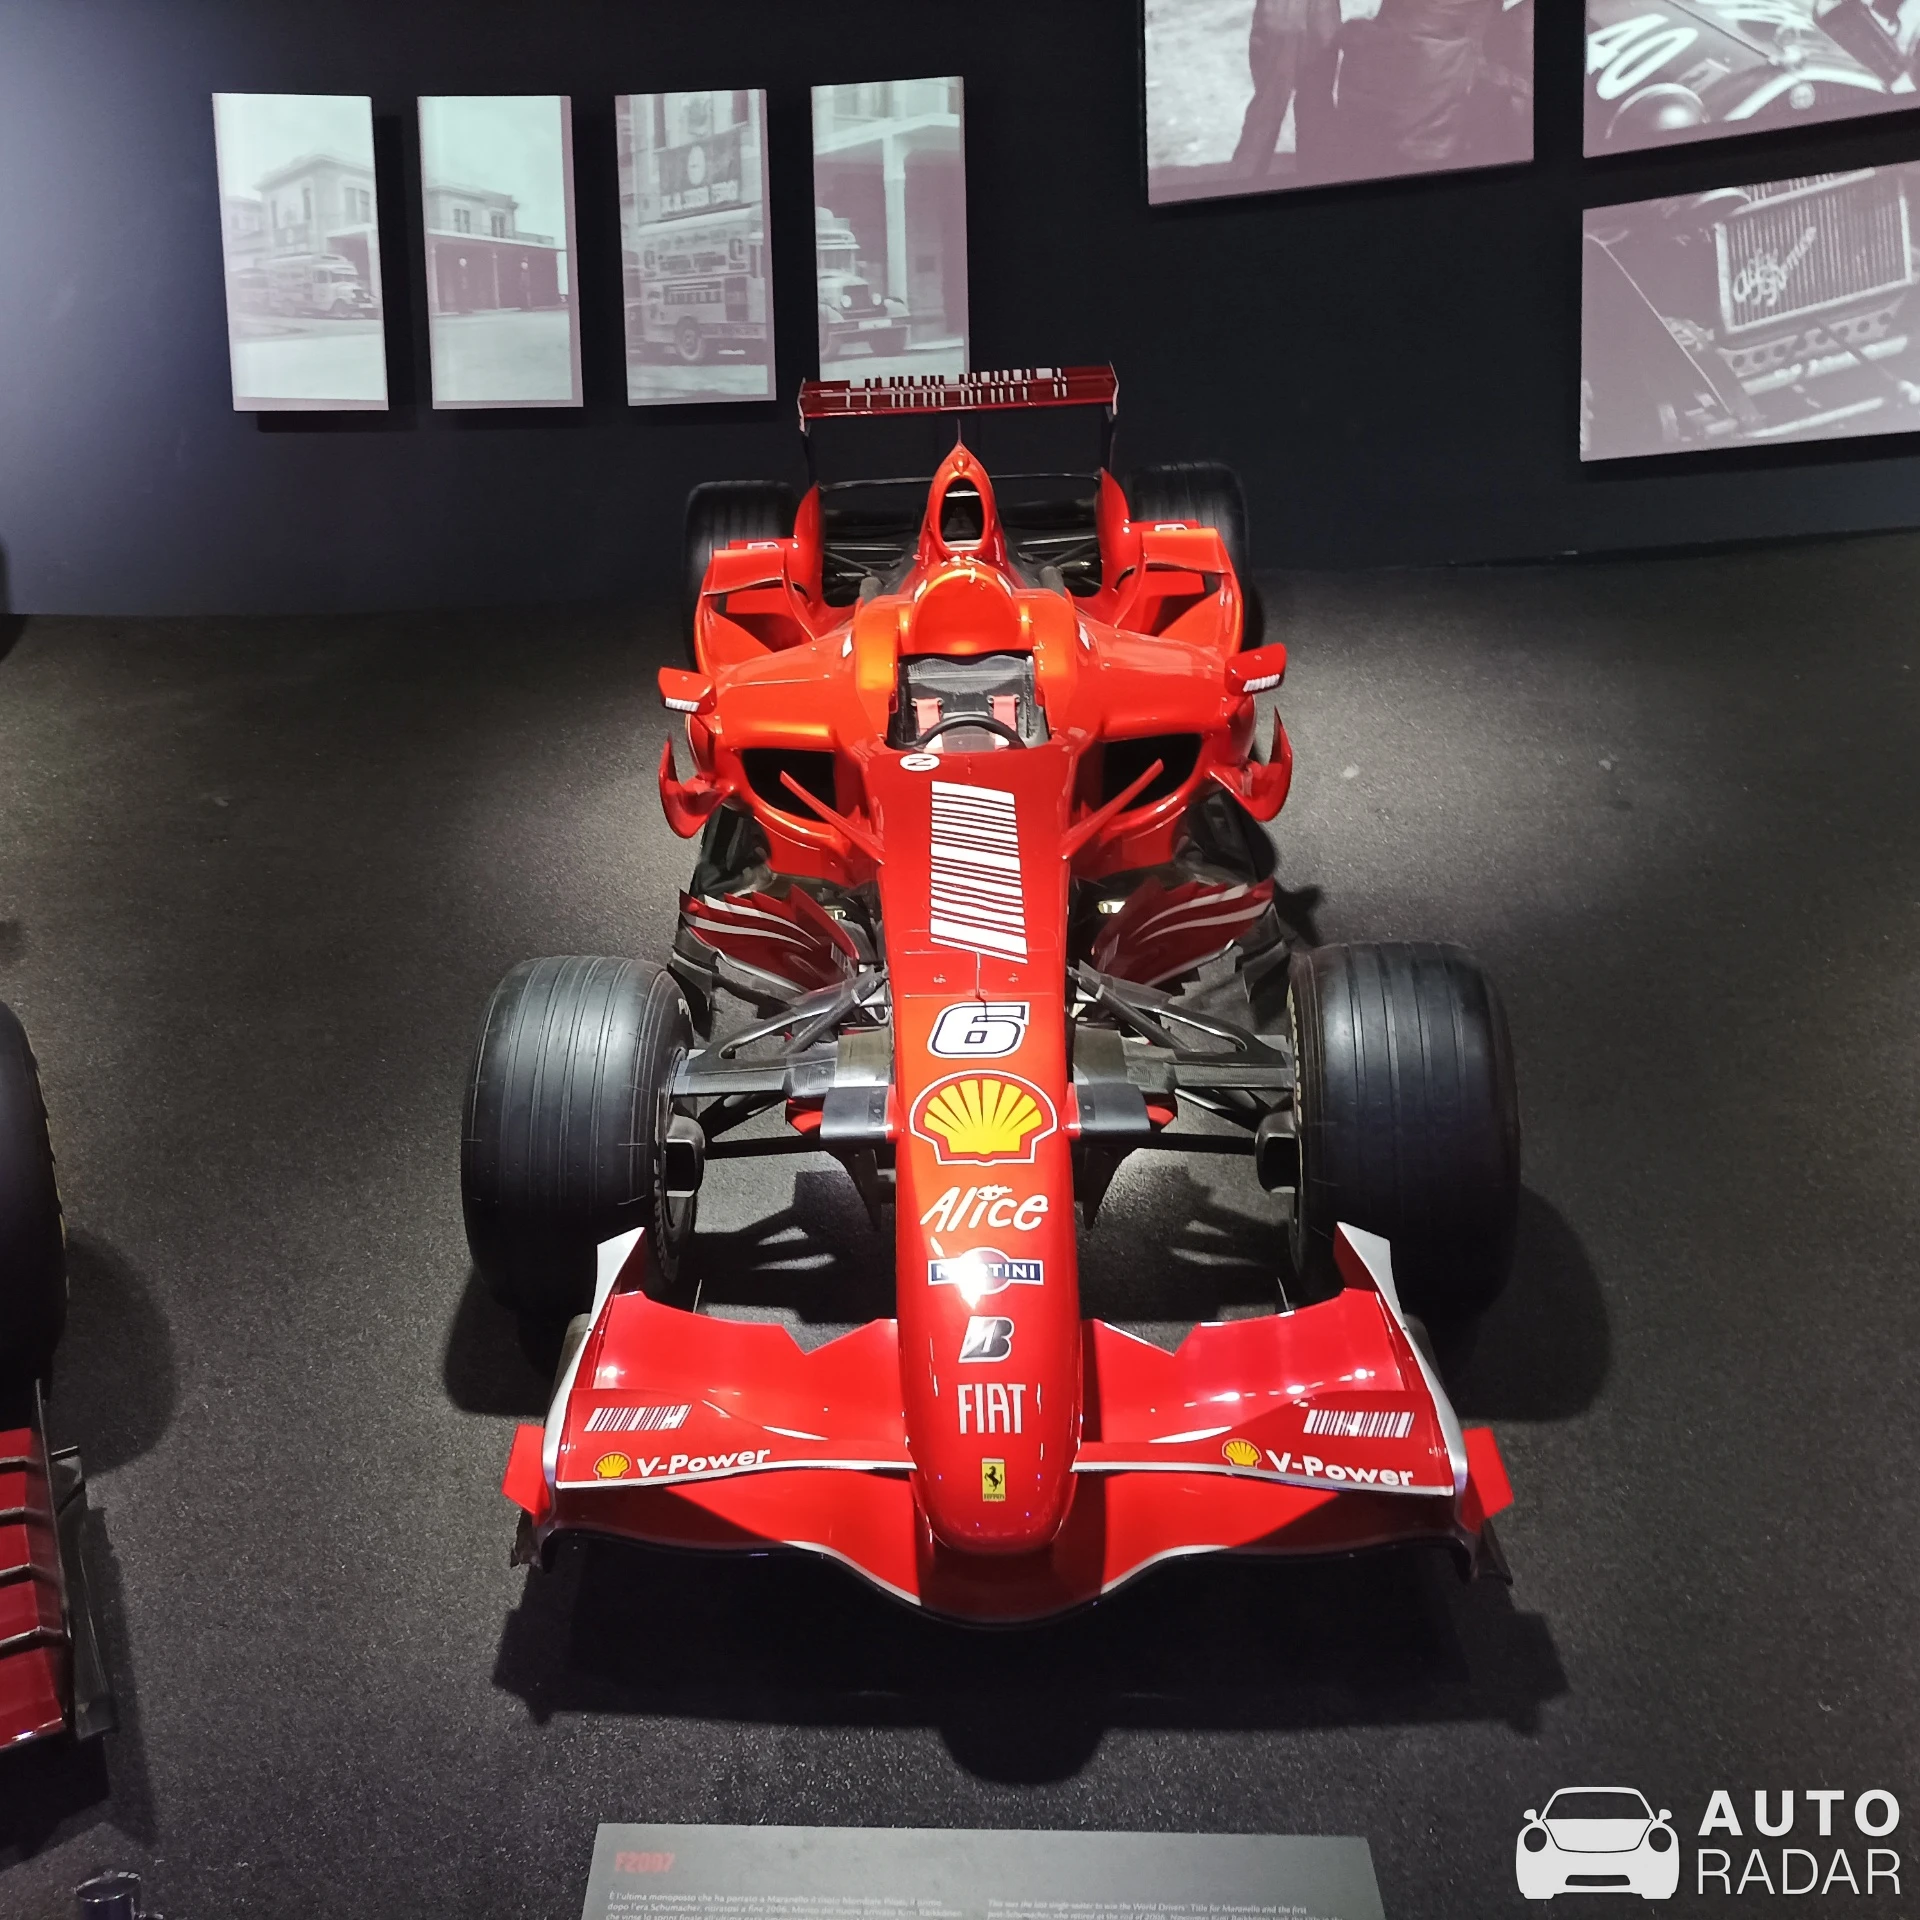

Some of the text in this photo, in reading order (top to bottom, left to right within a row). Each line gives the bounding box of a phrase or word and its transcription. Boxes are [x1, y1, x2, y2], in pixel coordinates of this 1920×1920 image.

[1587, 13, 1698, 100] 40
[926, 1001, 1029, 1059] 6
[919, 1185, 1048, 1233] Alice
[934, 1262, 1036, 1280] MTINI
[957, 1382, 1027, 1435] FIAT
[636, 1448, 771, 1478] V-Power
[1265, 1449, 1414, 1487] V-Power
[608, 1903, 629, 1912] dopo
[631, 1903, 648, 1911] l'era
[651, 1904, 702, 1912] Schumacher,
[649, 1894, 696, 1902] monoposto
[726, 1896, 758, 1904] portato
[1133, 1903, 1157, 1911] World
